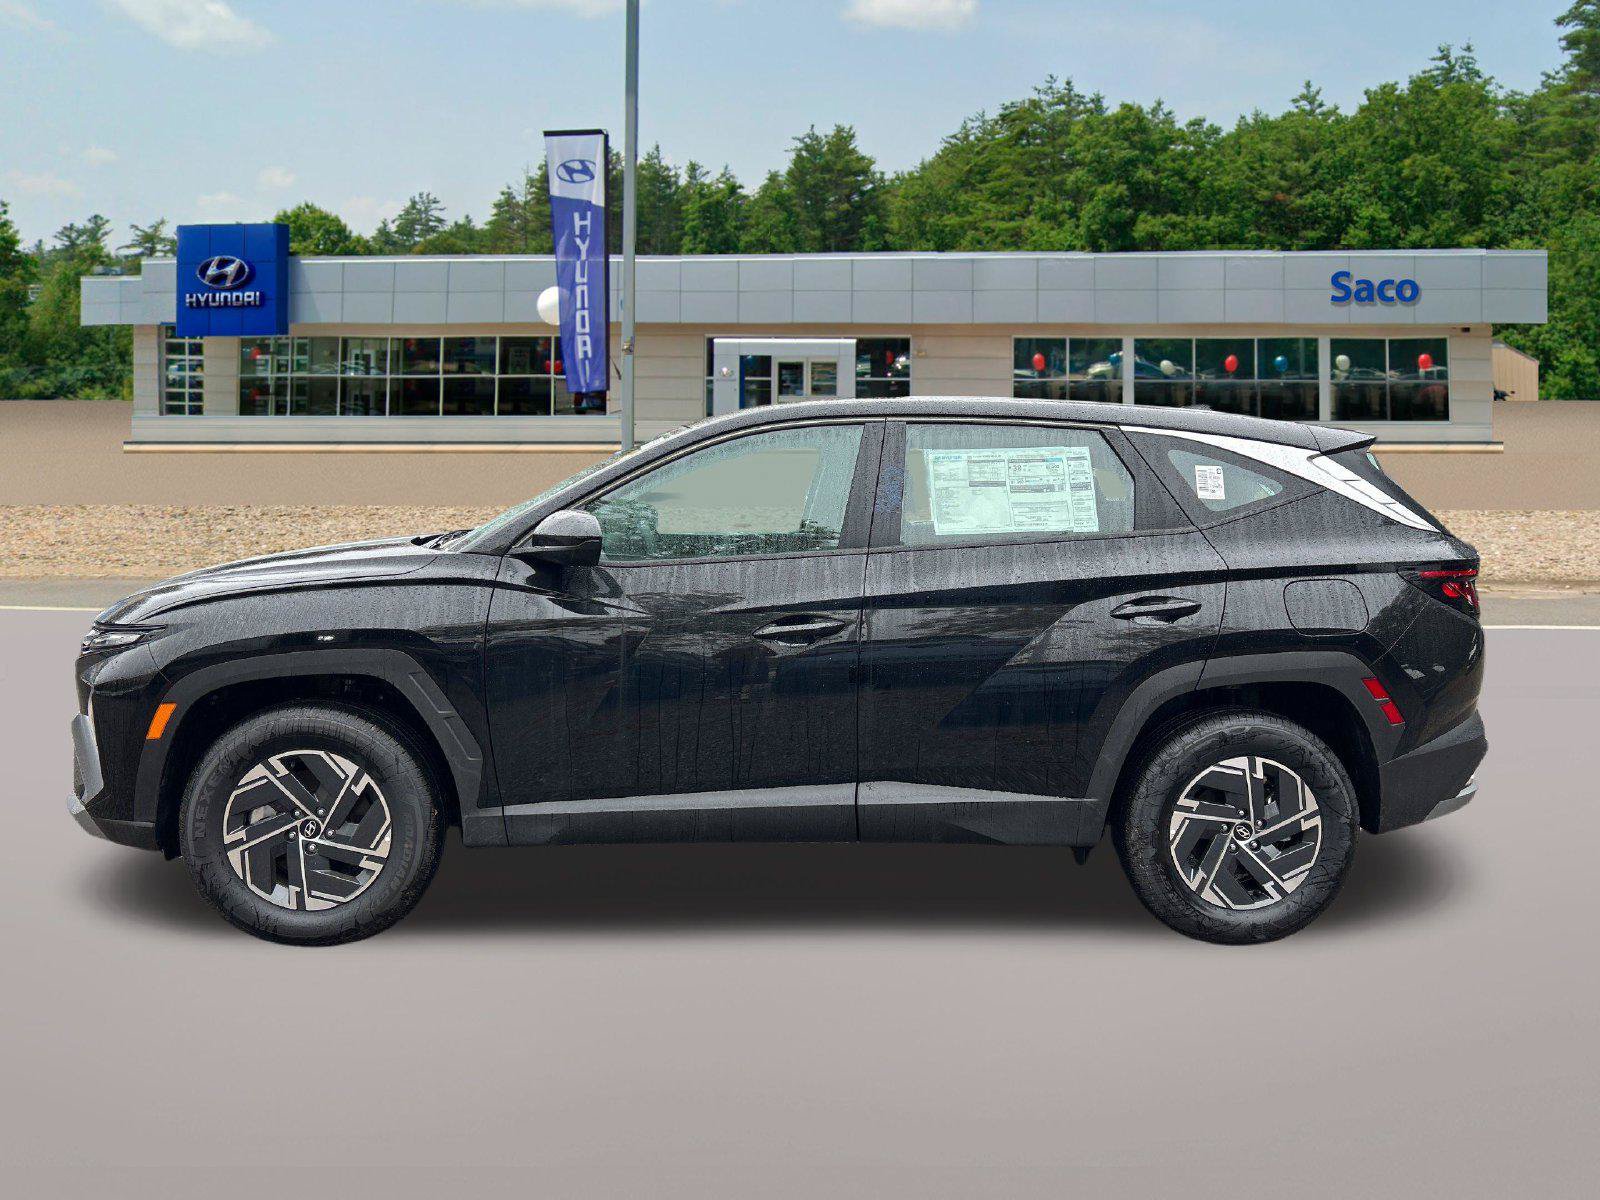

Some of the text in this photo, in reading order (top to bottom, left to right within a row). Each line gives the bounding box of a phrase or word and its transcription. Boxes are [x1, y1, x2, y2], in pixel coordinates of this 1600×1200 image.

[185, 292, 260, 307] HYUNDAI
[573, 211, 592, 386] HYUNDAI
[1330, 270, 1420, 302] Saco
